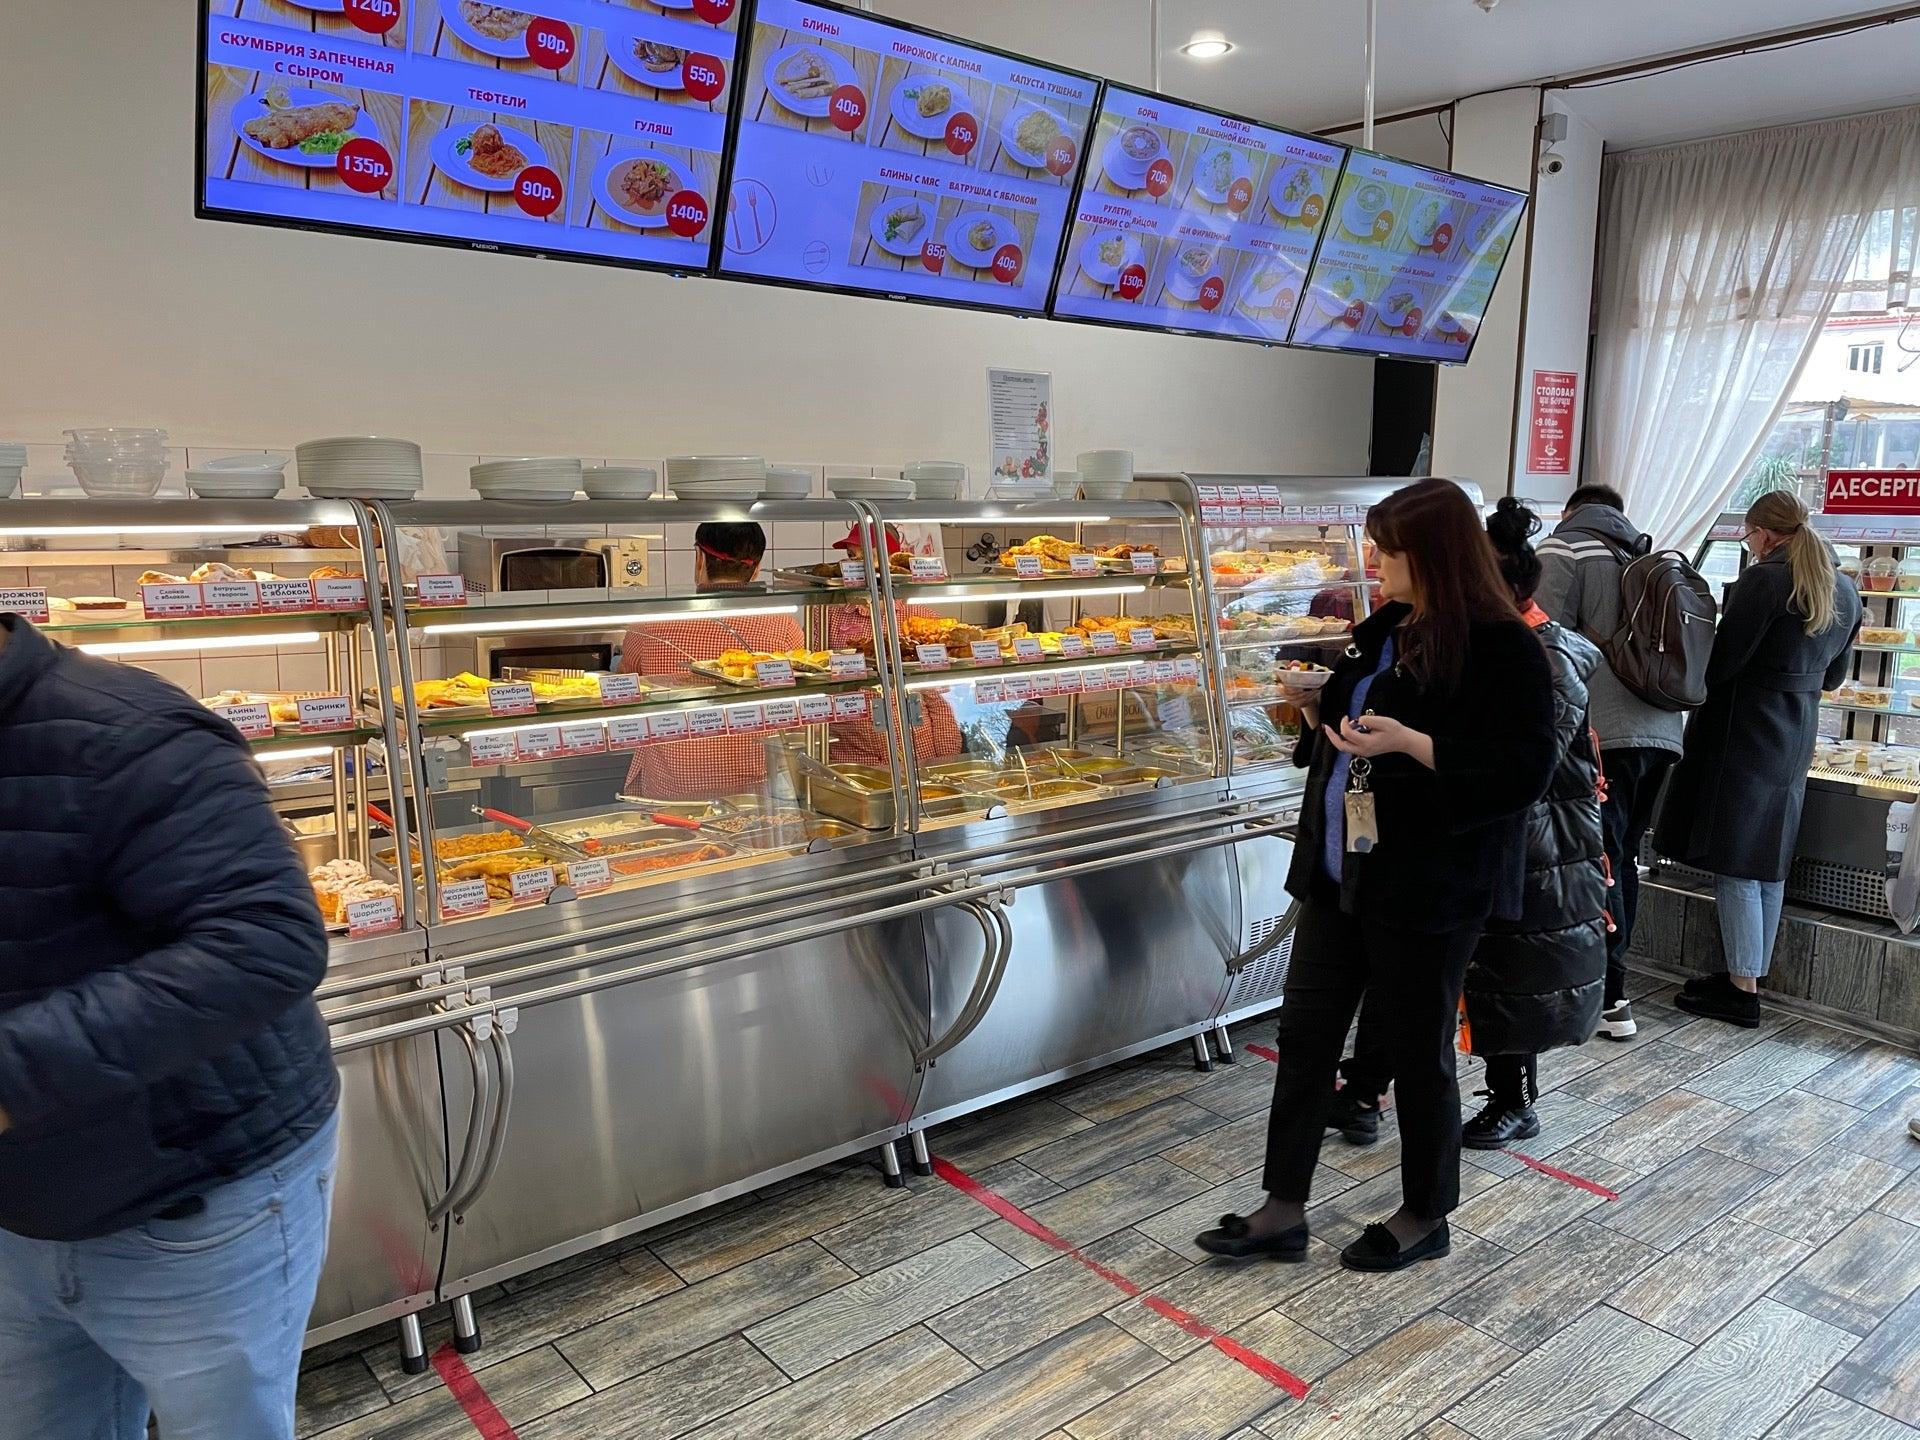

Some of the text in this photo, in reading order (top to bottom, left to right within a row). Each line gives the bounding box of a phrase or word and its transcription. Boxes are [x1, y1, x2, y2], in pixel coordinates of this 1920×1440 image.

[802, 17, 840, 36] БЛИНЫ
[537, 32, 570, 54] 90р.
[220, 32, 395, 74] СКУМБРИЯ ЗАПЕЧЕНАЯ
[892, 41, 938, 62] ПИРОЖОК
[938, 55, 946, 64] С
[274, 61, 344, 84] С СЫРОМ
[689, 66, 718, 86] 55р.
[1009, 73, 1083, 99] КАПУСТА ТУШЕНАЯ
[468, 88, 527, 109] ТЕФТЕЛИ
[835, 99, 862, 118] 40р.
[1137, 107, 1159, 121] БОРЩ
[634, 120, 673, 137] ГУЛЯШ
[1220, 119, 1251, 133] САЛАТ ИЗ
[951, 125, 974, 146] 45р.
[1197, 126, 1267, 149] КВАШЕННОЙ КАПУСТЫ
[1052, 148, 1072, 165] 45р.
[1285, 145, 1305, 157] САЛАТ
[343, 154, 389, 178] 135р.
[880, 168, 941, 187] БЛИНЫ С МЯС
[1151, 169, 1168, 186] 70р.
[521, 180, 556, 201] 90р.
[948, 181, 1037, 205] ВАТРУШКА С ЯБЛОКОМ
[670, 203, 706, 224] 140р.
[1079, 213, 1118, 228] СКУМБРИИ
[1123, 220, 1131, 229] О
[1178, 225, 1191, 236] ЩИ
[997, 256, 1017, 271] 40р.
[1121, 274, 1144, 289] 130р.
[1536, 386, 1574, 397] СТОЛОВАЯ
[1829, 477, 1920, 499] ДЕСЕРТ
[261, 582, 308, 591] Ватрушка
[270, 589, 310, 597] яблоком
[490, 687, 530, 696] Скумбрия
[227, 707, 257, 715] Блины
[304, 703, 346, 713] Сырники
[766, 703, 793, 711] Голубцы
[767, 709, 793, 717] ленивые
[691, 717, 722, 726] отварная
[694, 712, 718, 720] Гречка
[574, 868, 605, 878] жареный
[575, 862, 601, 871] Минтай
[516, 870, 548, 880] Котлета
[518, 877, 548, 889] рыбная
[446, 890, 484, 901] жареный
[360, 901, 382, 910] Пирог
